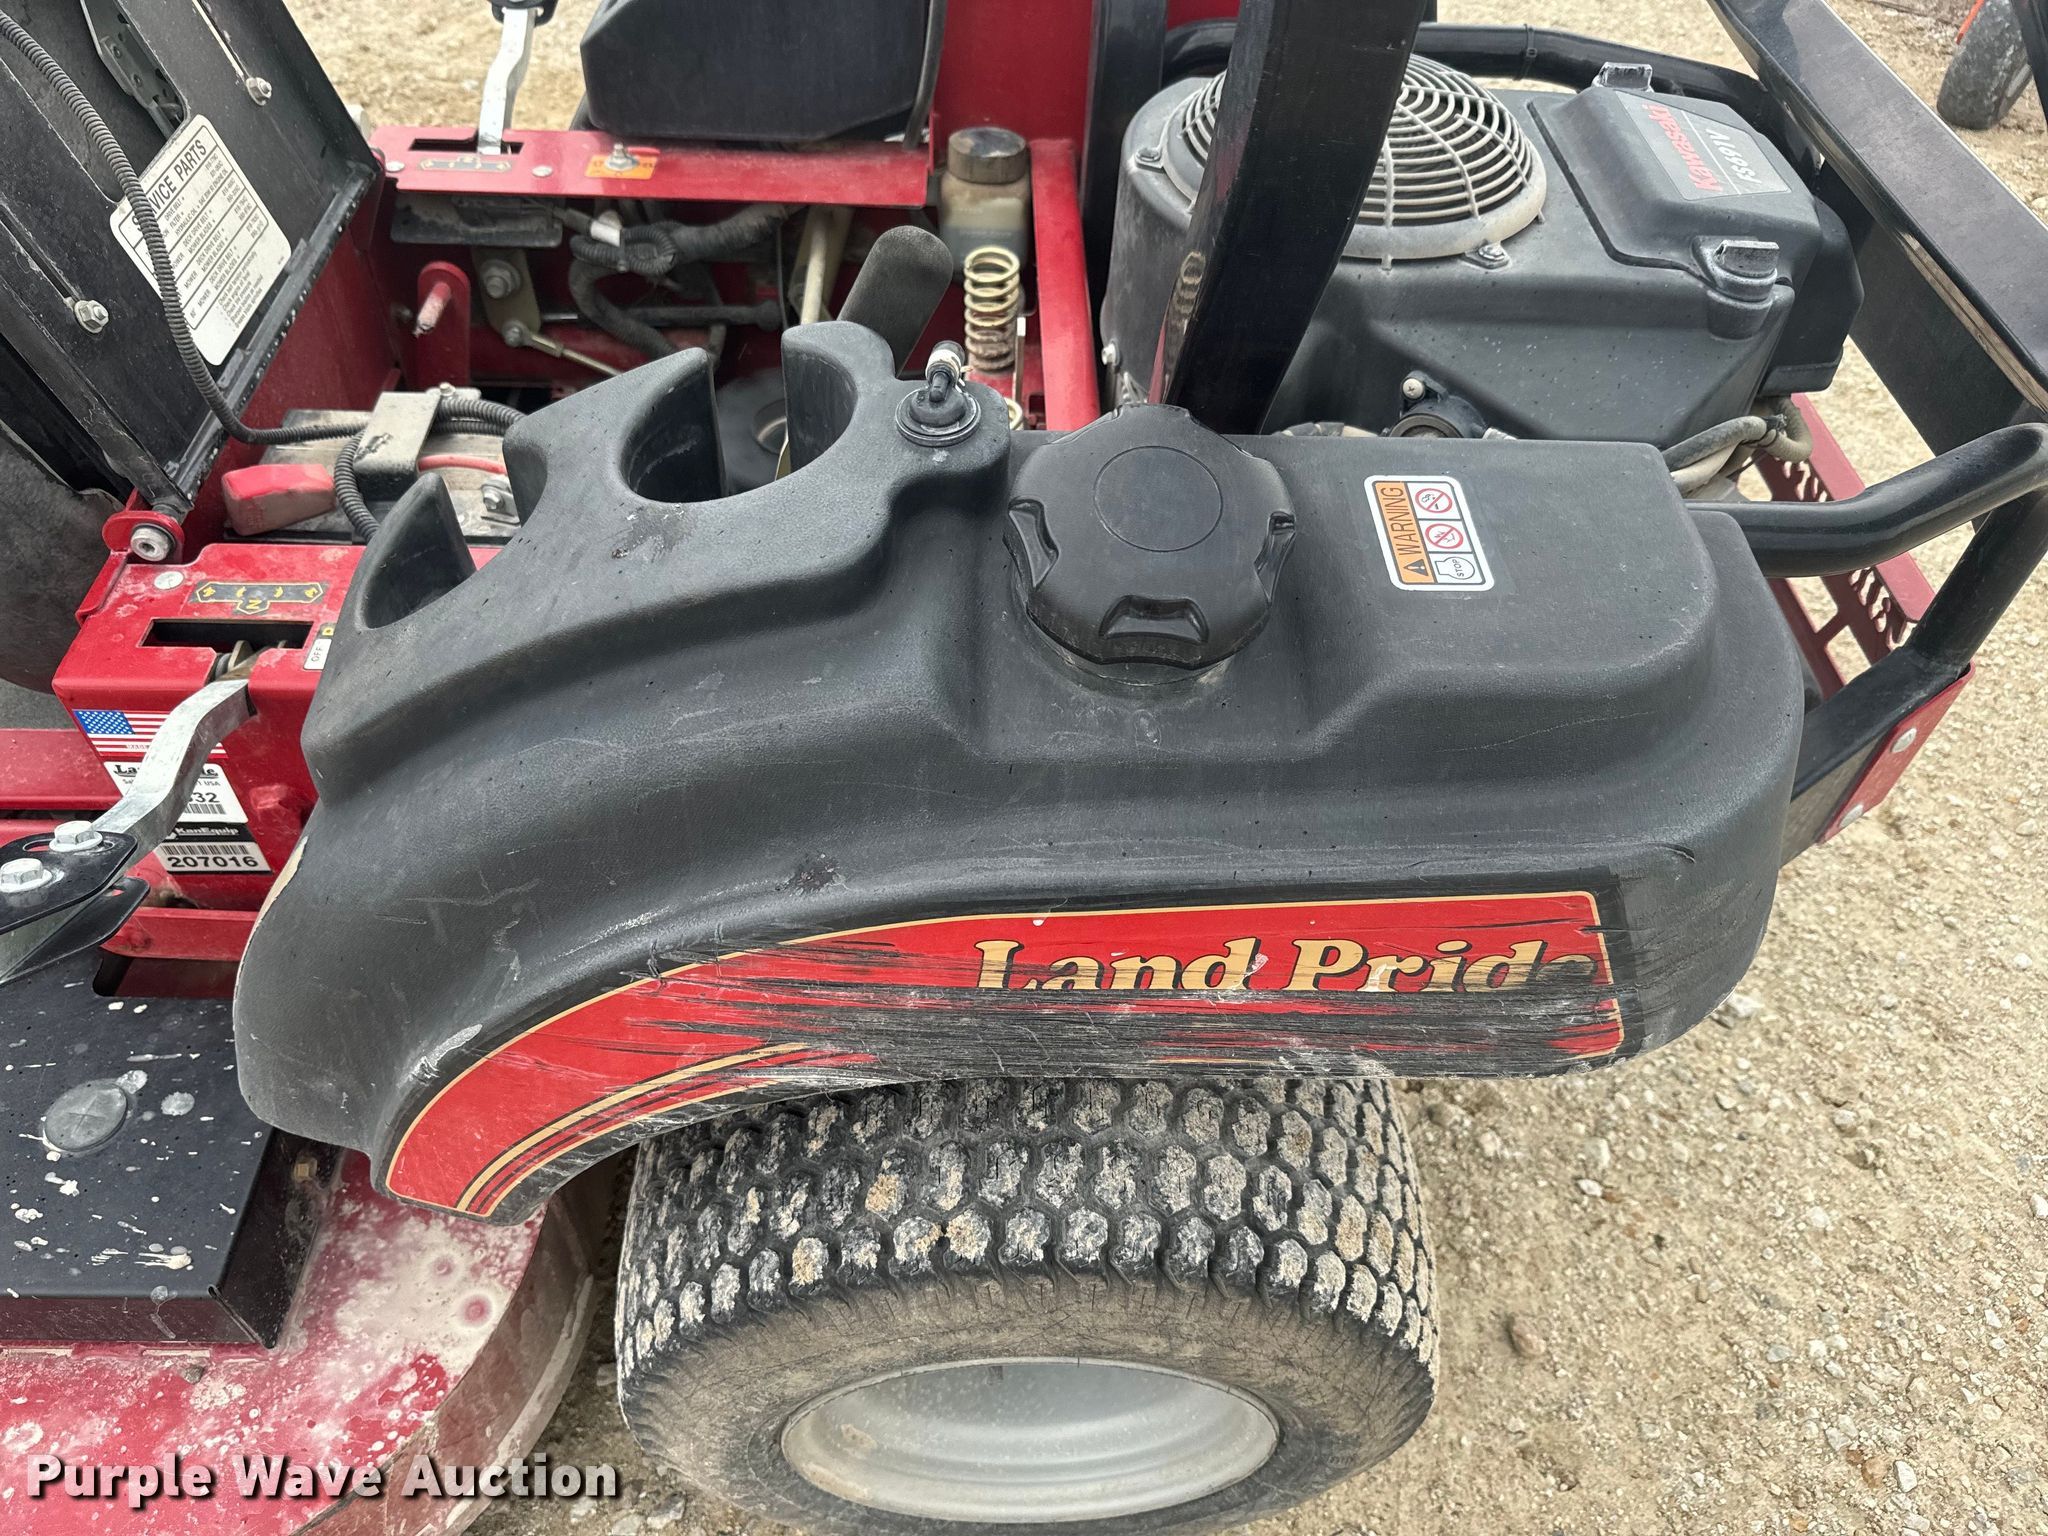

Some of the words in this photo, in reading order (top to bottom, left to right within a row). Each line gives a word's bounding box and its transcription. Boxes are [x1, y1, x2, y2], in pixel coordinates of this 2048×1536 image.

[1642, 104, 1724, 192] Kawasaki
[1705, 128, 1762, 184] FS691V
[173, 138, 207, 181] PARTS
[172, 198, 182, 210] BELT
[169, 212, 181, 229] FILTER
[199, 211, 209, 224] BELT
[183, 269, 198, 290] MOWER
[1381, 487, 1422, 556] WARNING
[1452, 558, 1464, 577] STOP
[174, 827, 239, 835] KanEquip
[167, 856, 259, 867] 207016
